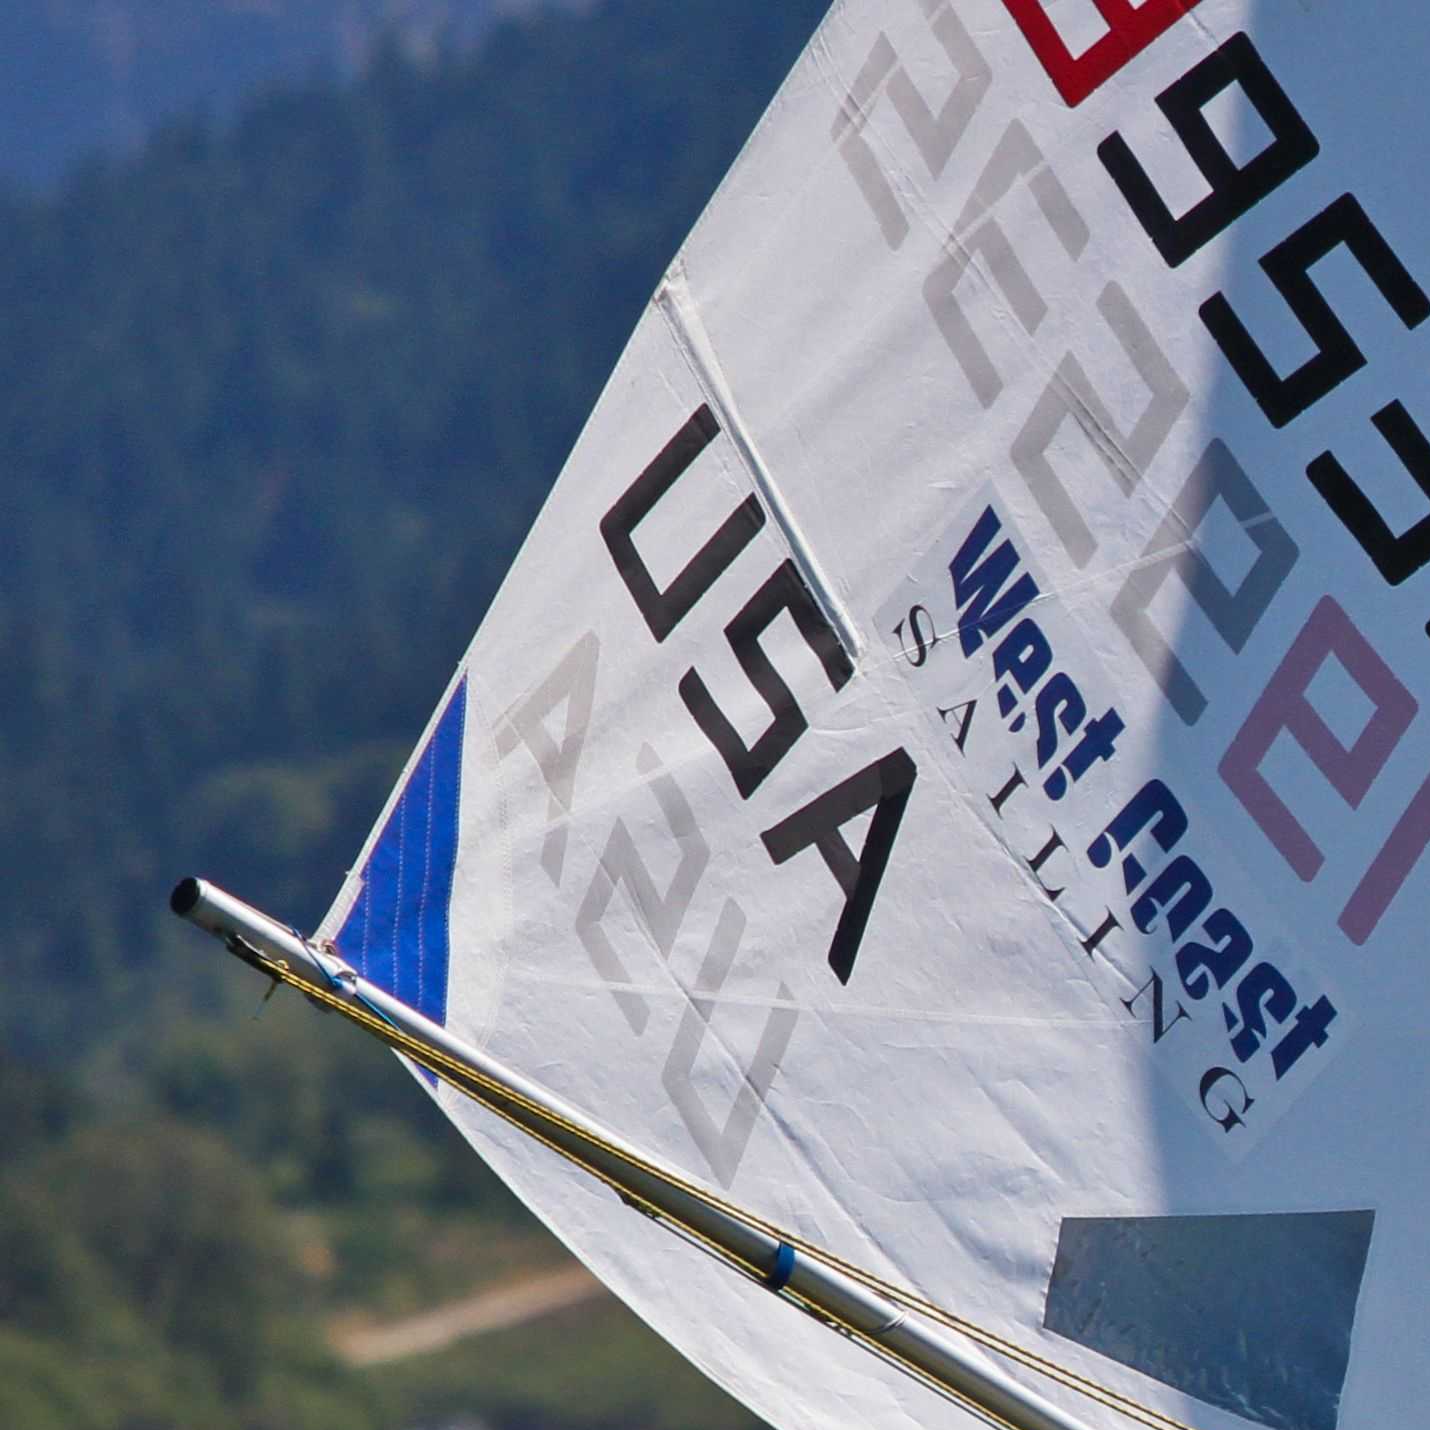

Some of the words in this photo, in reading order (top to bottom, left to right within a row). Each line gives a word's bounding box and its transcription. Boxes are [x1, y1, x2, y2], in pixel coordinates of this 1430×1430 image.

[600, 403, 919, 985] USA
[893, 604, 1255, 1133] SAILING
[949, 504, 1126, 801] West
[1087, 779, 1338, 1081] Coast
